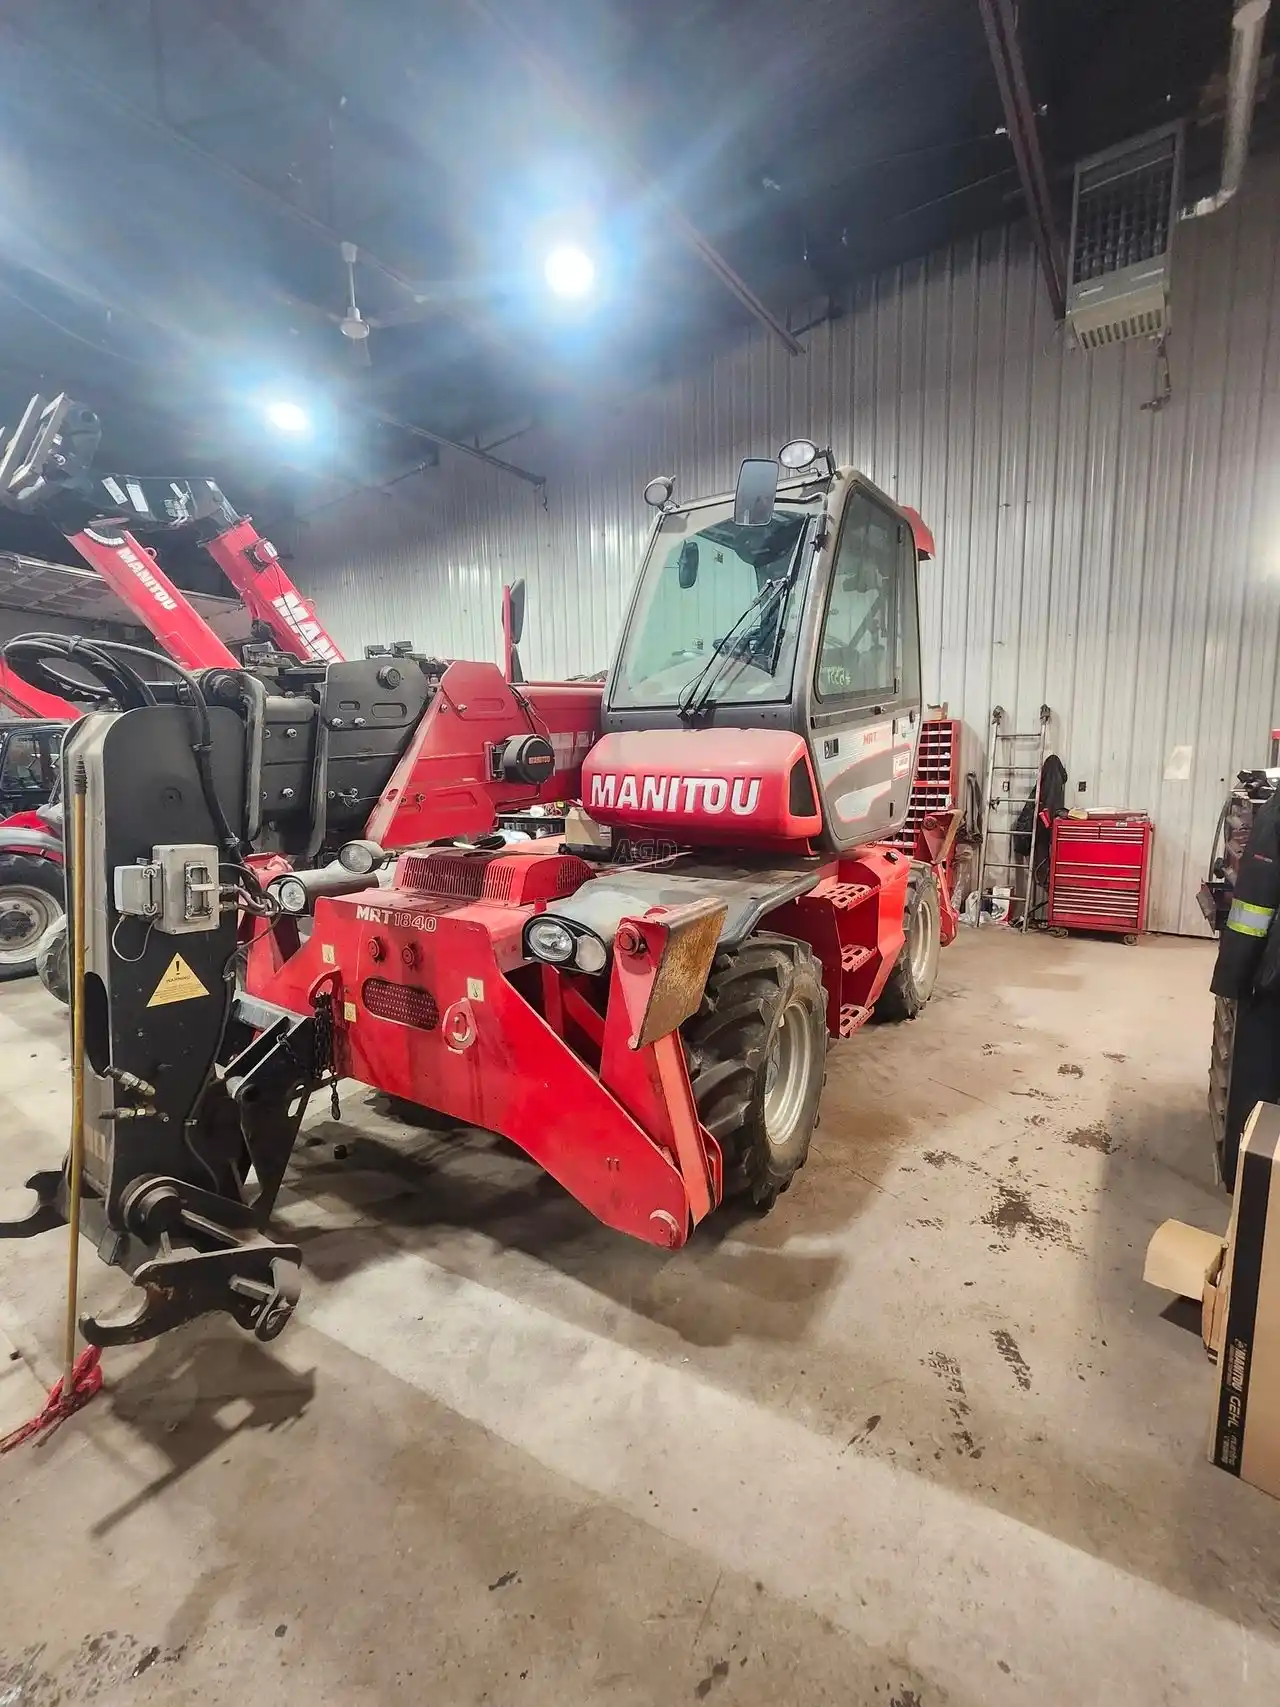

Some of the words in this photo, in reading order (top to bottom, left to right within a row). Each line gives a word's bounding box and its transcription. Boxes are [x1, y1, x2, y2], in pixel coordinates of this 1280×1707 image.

[116, 546, 178, 611] MANITOU
[590, 774, 762, 816] MANITOU
[356, 904, 393, 925] MRT
[394, 911, 437, 932] 1840
[1231, 1347, 1247, 1392] MANITOU
[1227, 1395, 1241, 1428] GEHL
